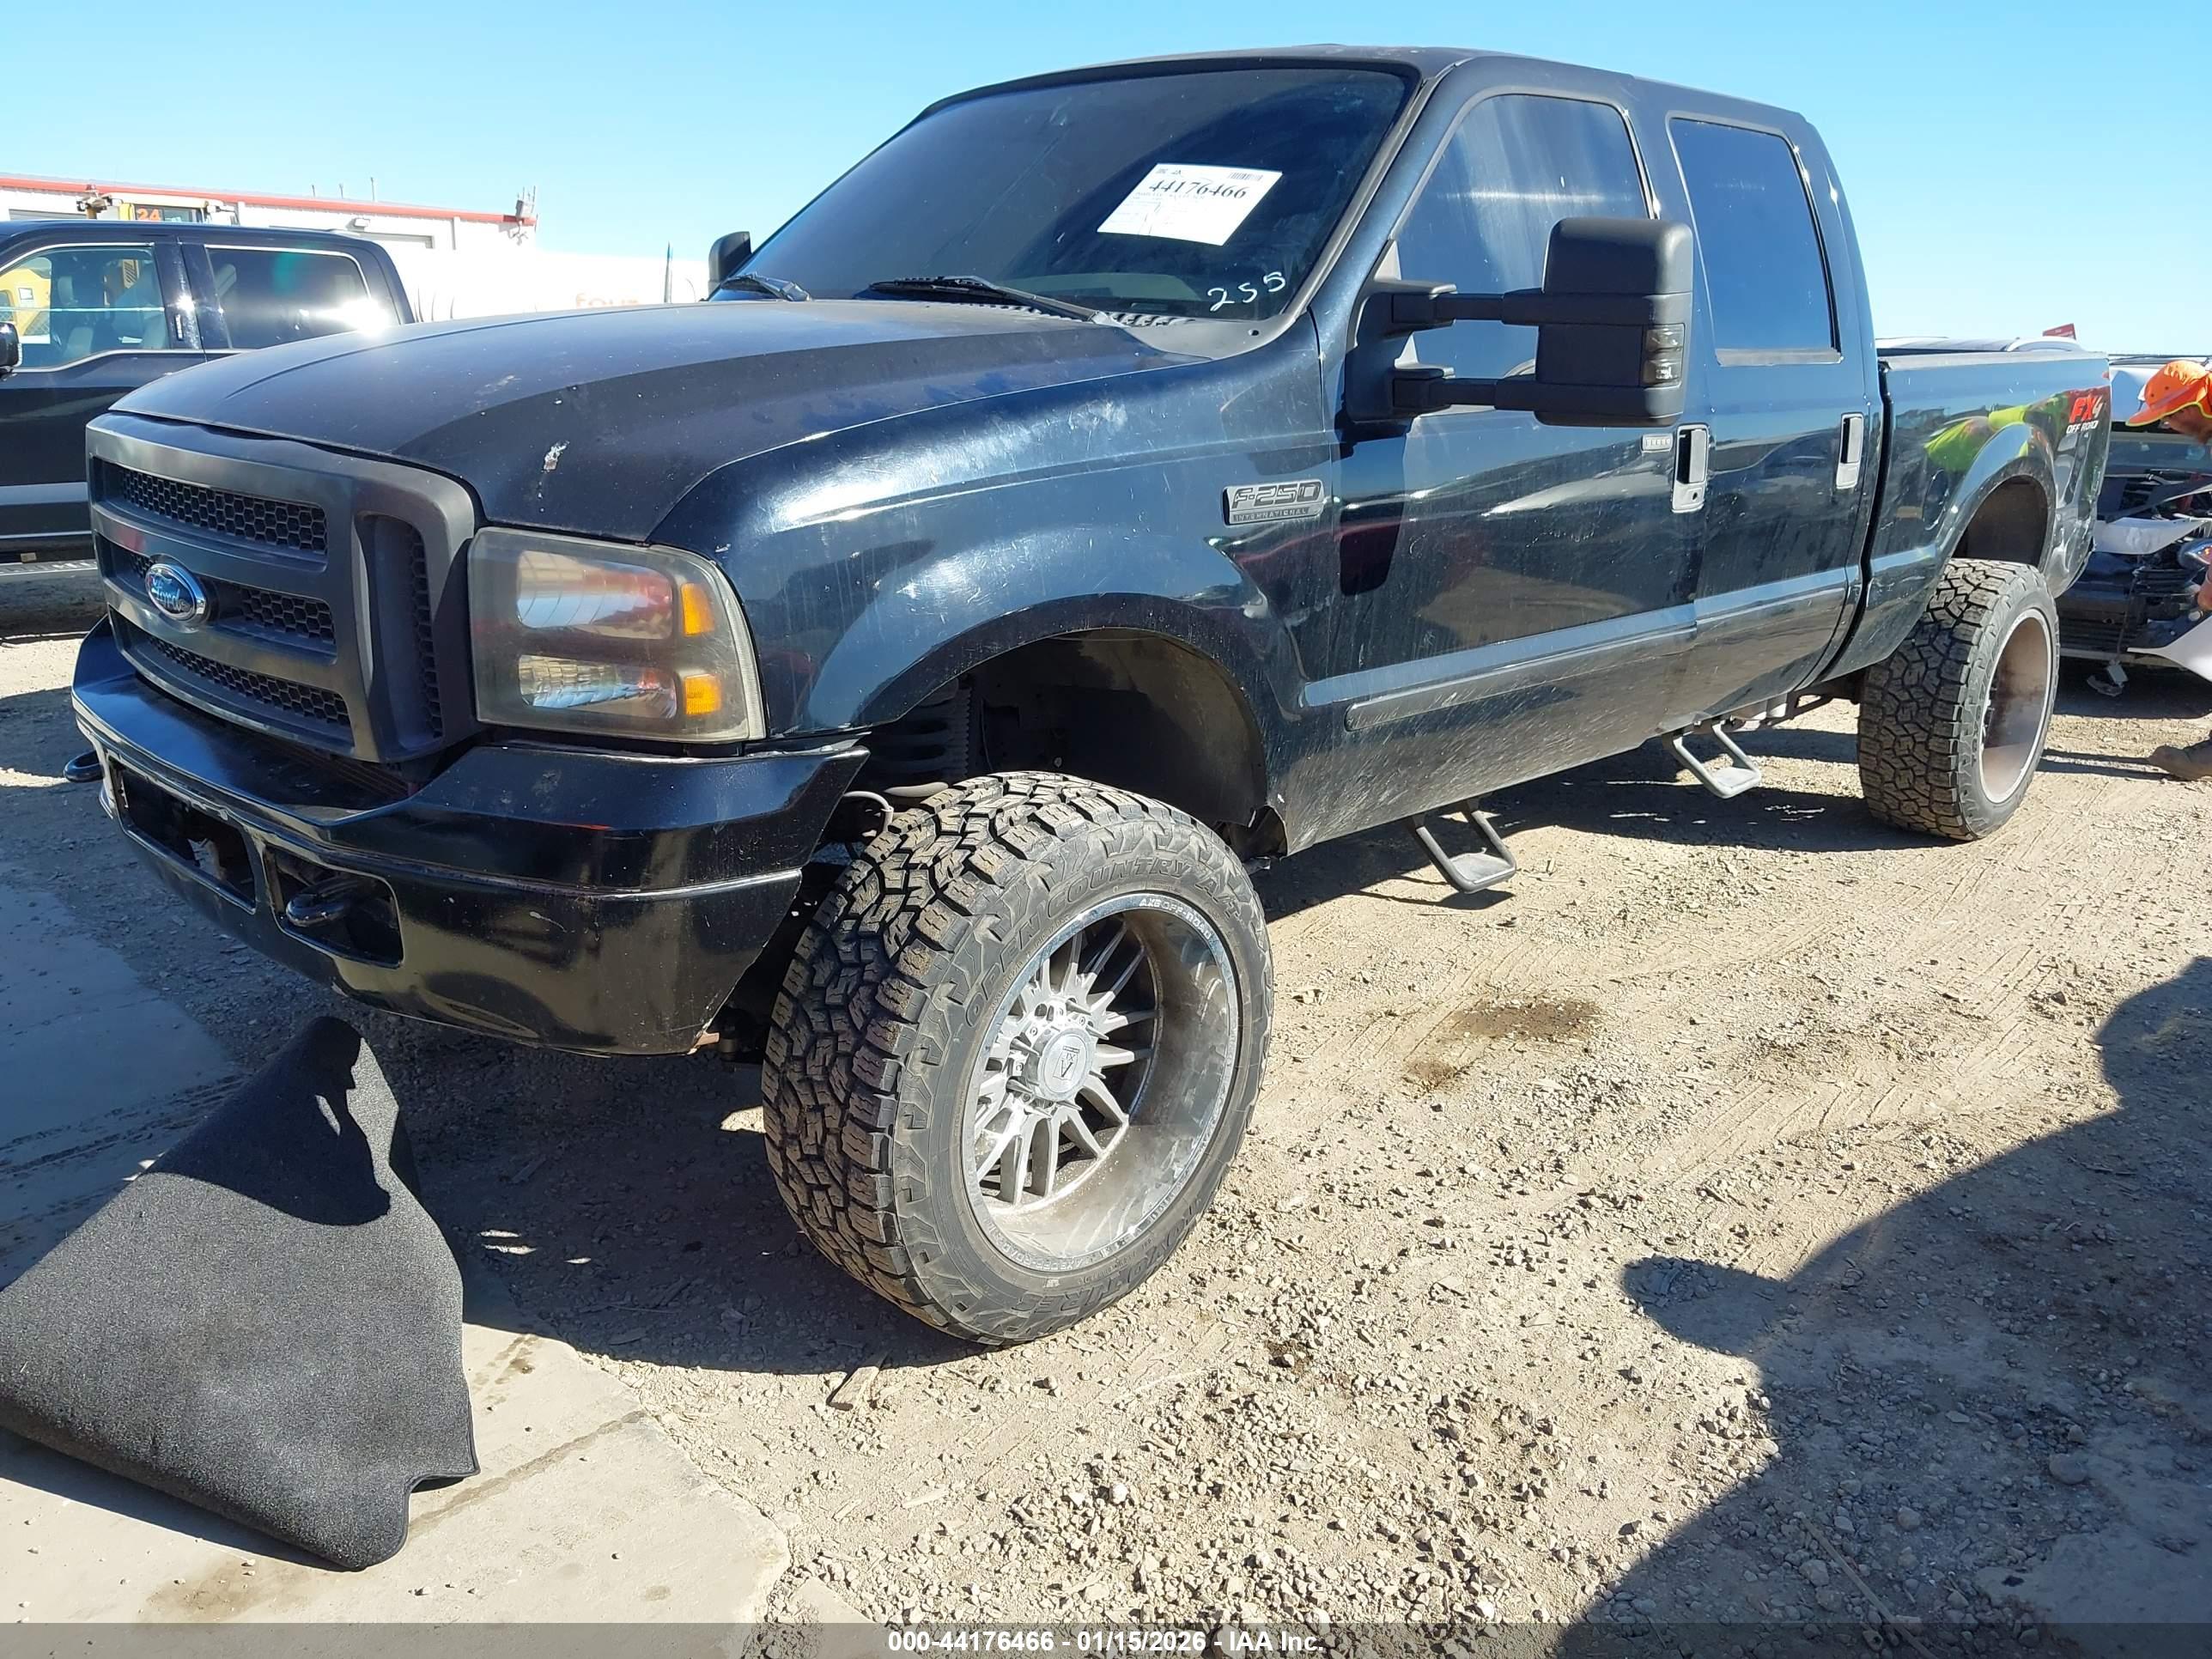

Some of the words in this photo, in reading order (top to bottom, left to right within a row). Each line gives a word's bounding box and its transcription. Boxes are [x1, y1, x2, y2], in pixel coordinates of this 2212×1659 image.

[1149, 179, 1250, 199] 44176466
[2069, 395, 2103, 423] FX4
[2066, 423, 2081, 434] OFF
[2081, 420, 2100, 432] ROAD
[1231, 481, 1322, 509] F-250
[150, 574, 181, 611] Ford
[966, 913, 1042, 1028] OPEN
[1047, 857, 1192, 919] COUNTRY
